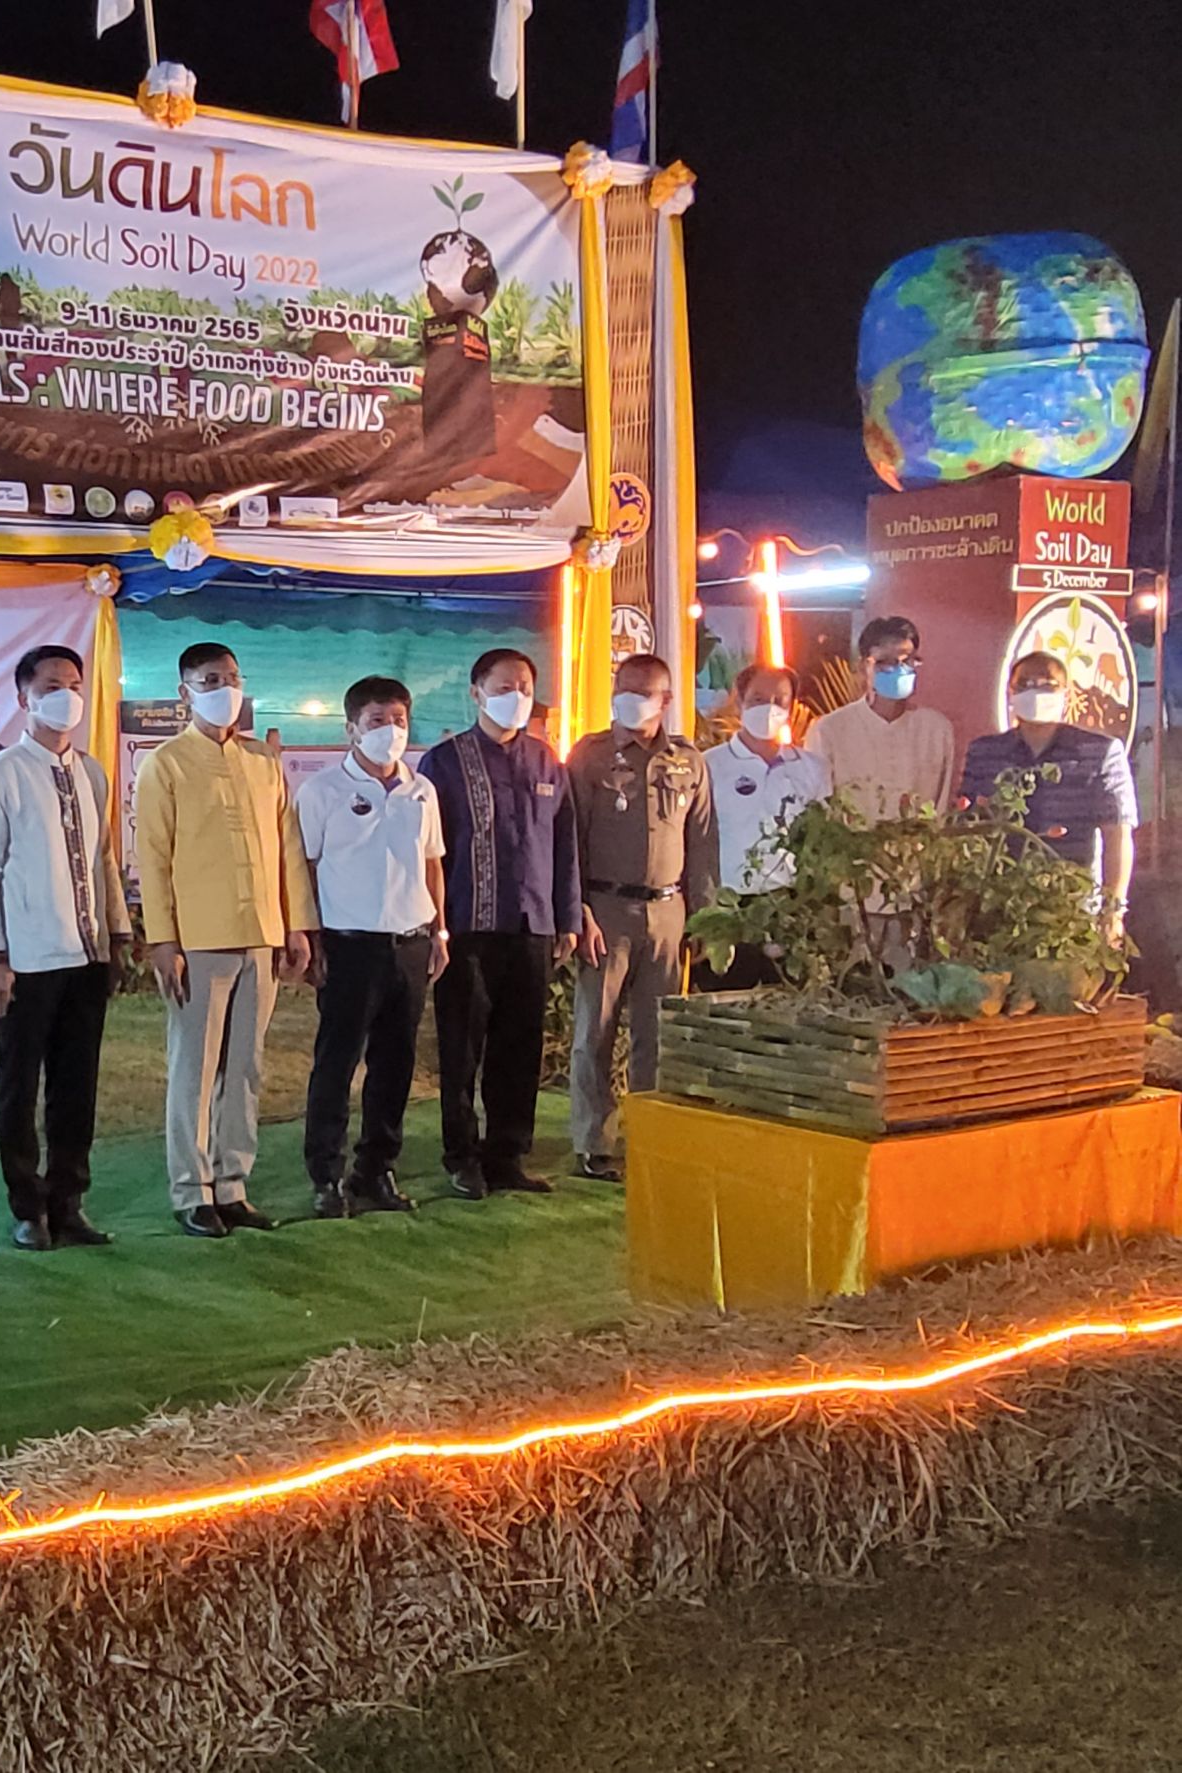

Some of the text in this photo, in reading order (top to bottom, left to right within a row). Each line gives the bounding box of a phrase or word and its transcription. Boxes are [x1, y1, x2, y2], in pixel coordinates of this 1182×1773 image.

[9, 122, 317, 230] วันดินโลก
[12, 213, 318, 291] World Soil Day 2022
[60, 302, 111, 326] 9-11
[120, 306, 198, 334] ธันวาคม
[204, 317, 260, 341] 2565
[284, 298, 408, 336] จังหวัดน่าน
[316, 356, 411, 385] จังหวัดน่าน
[56, 368, 178, 417] WHERE
[188, 378, 272, 423] FOOD
[281, 389, 389, 432] BEGINS
[1045, 489, 1106, 526] World
[1035, 531, 1112, 569] Soil Day
[1042, 569, 1108, 589] 5 December
